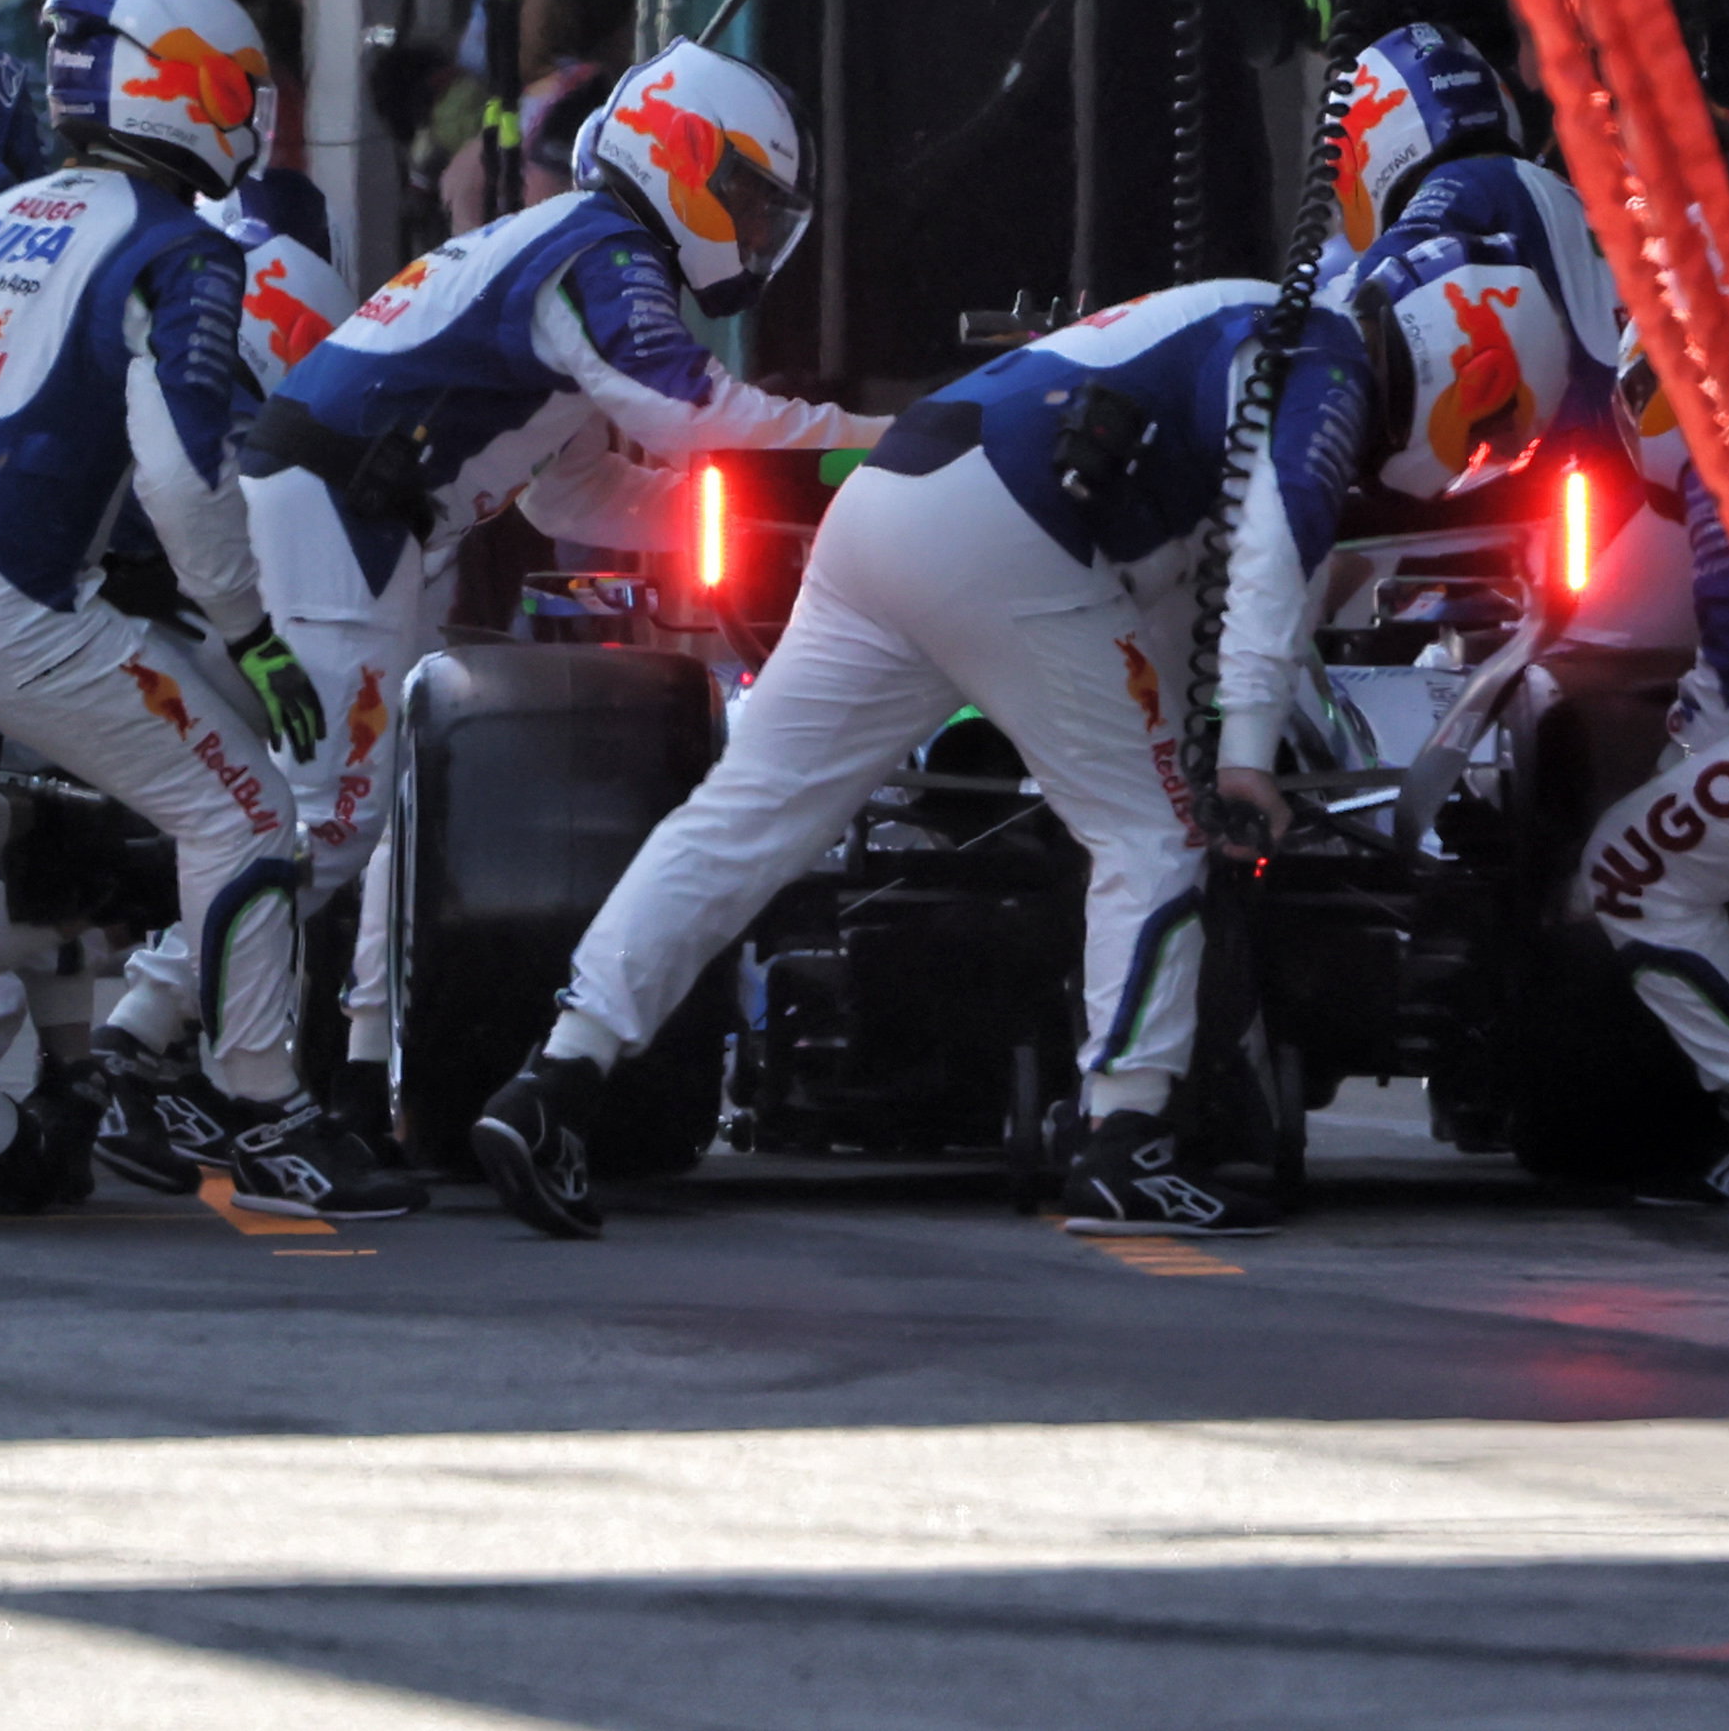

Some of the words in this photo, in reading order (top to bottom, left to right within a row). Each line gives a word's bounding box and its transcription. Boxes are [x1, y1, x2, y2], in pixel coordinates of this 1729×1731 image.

[8, 196, 88, 221] HUGO
[6, 273, 41, 296] App
[192, 730, 249, 788] Red
[232, 777, 282, 836] Bull
